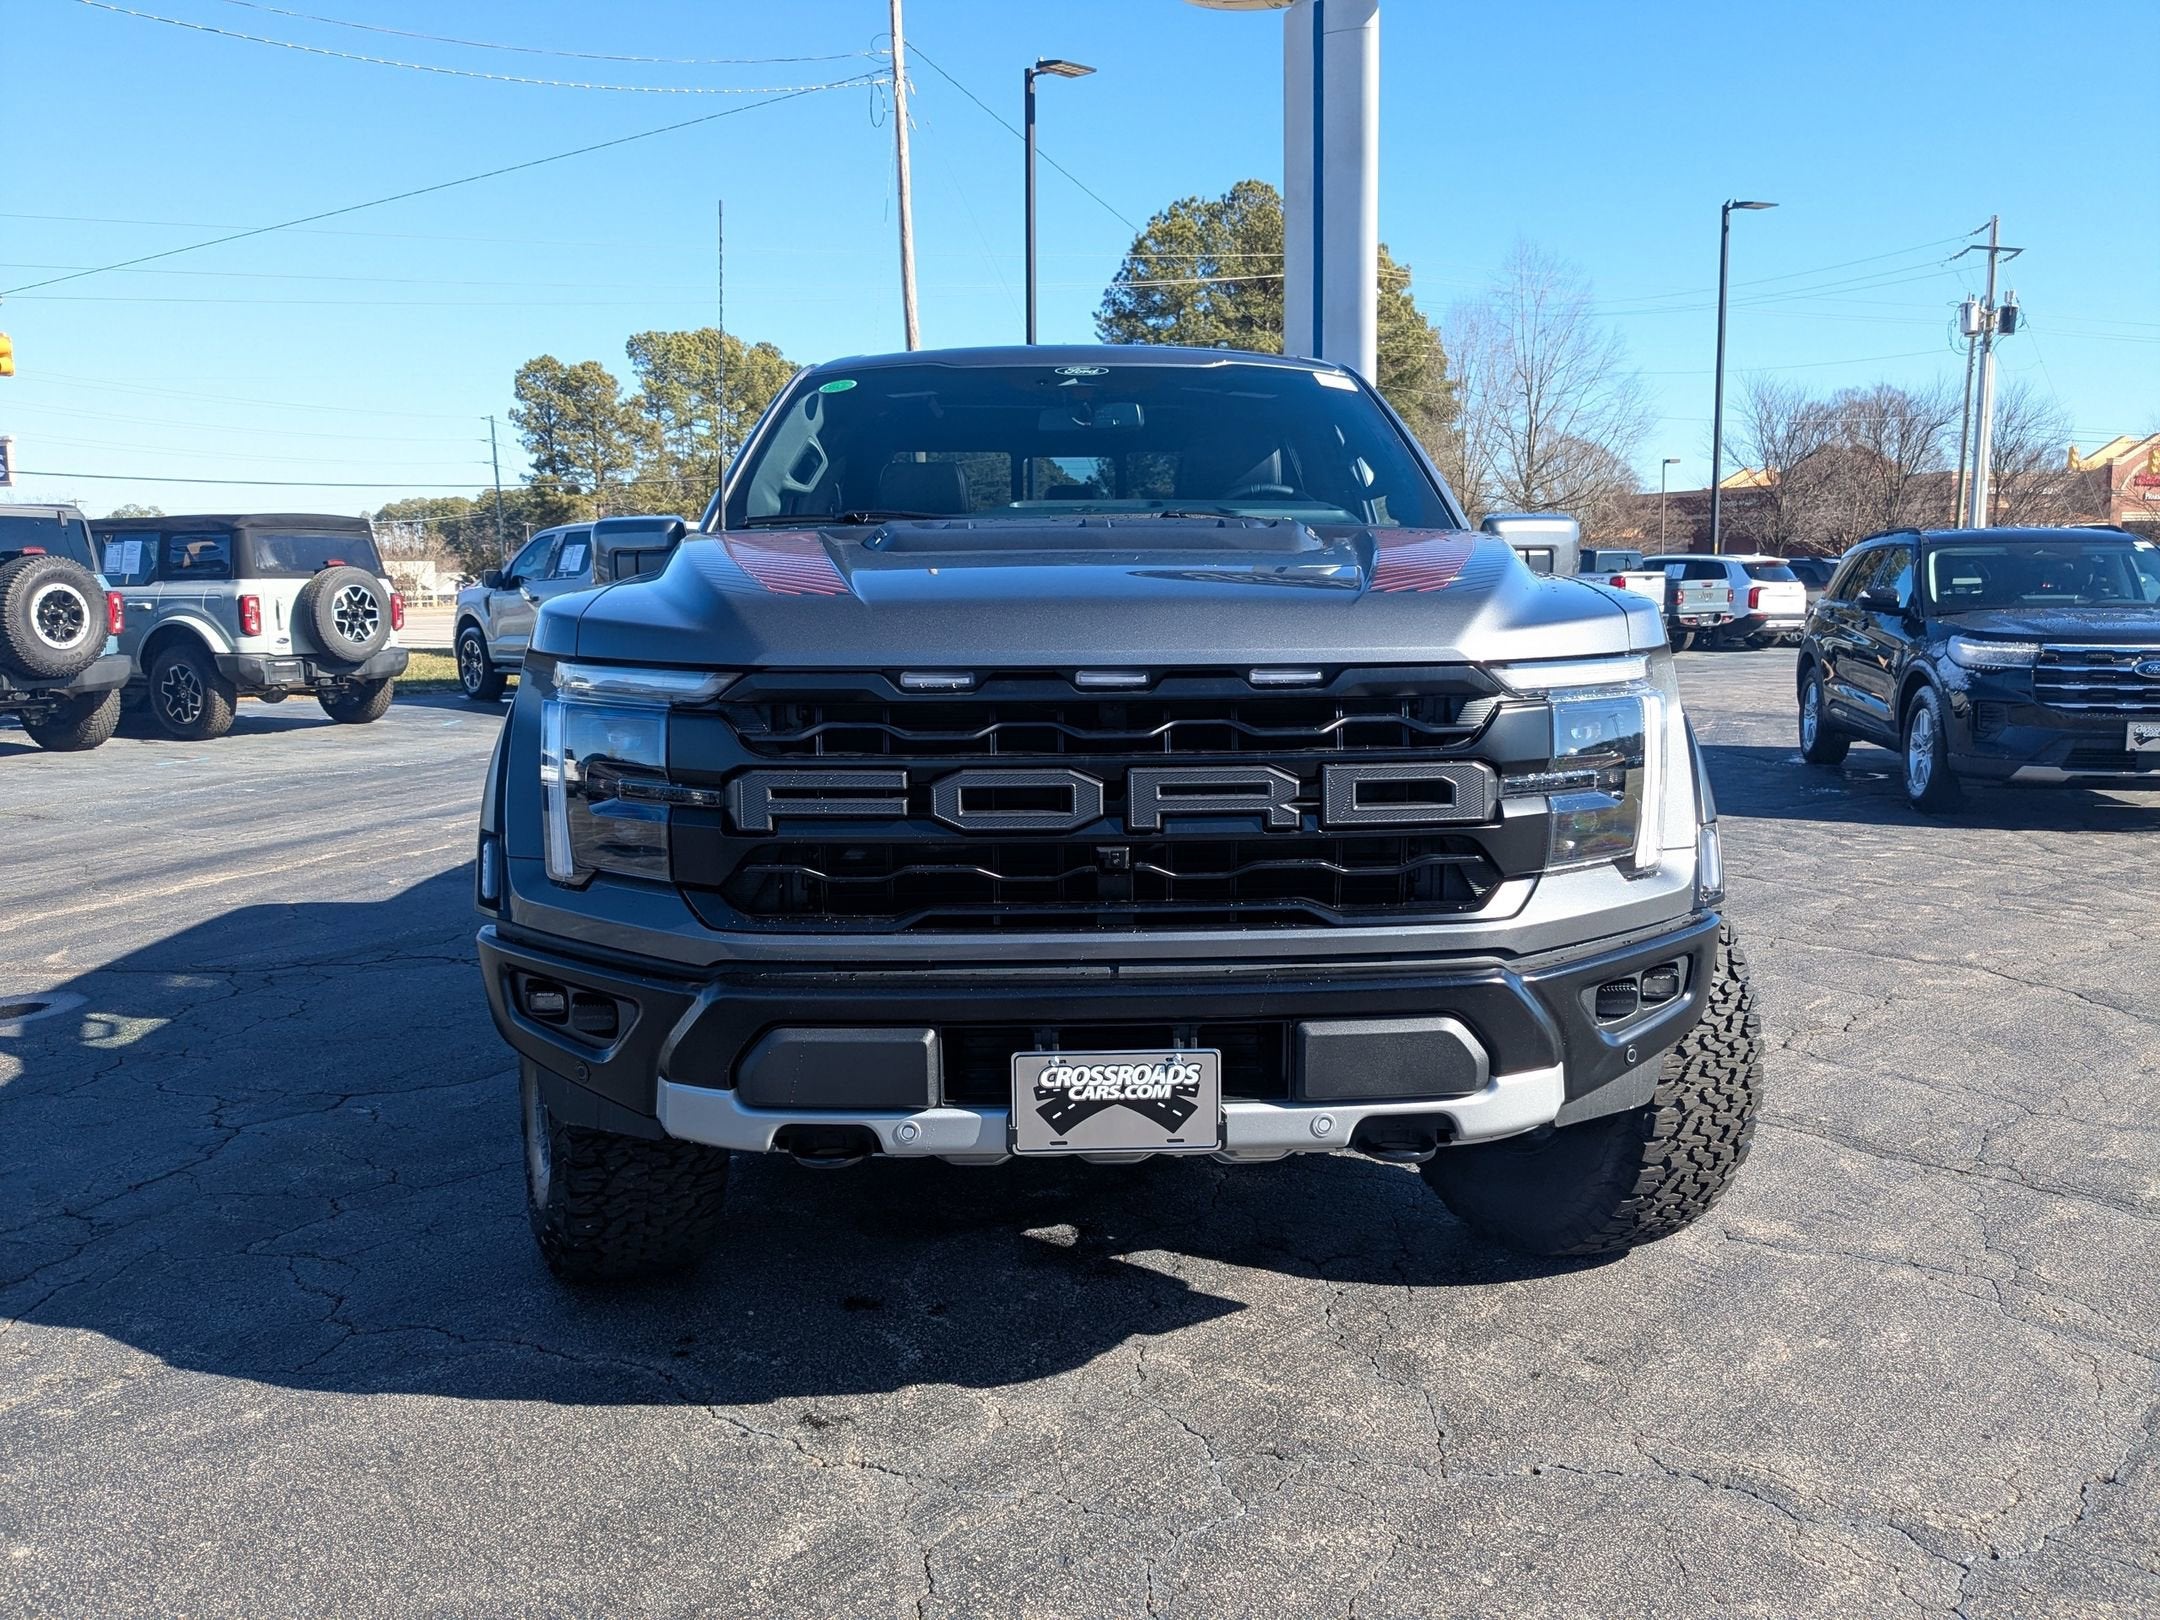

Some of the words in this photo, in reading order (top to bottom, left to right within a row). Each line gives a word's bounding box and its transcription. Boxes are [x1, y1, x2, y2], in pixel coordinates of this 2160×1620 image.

[1063, 366, 1100, 375] Ford
[726, 760, 1498, 832] FORD
[1038, 1064, 1202, 1089] CROSSROADS
[1067, 1084, 1172, 1101] CARS.COM
